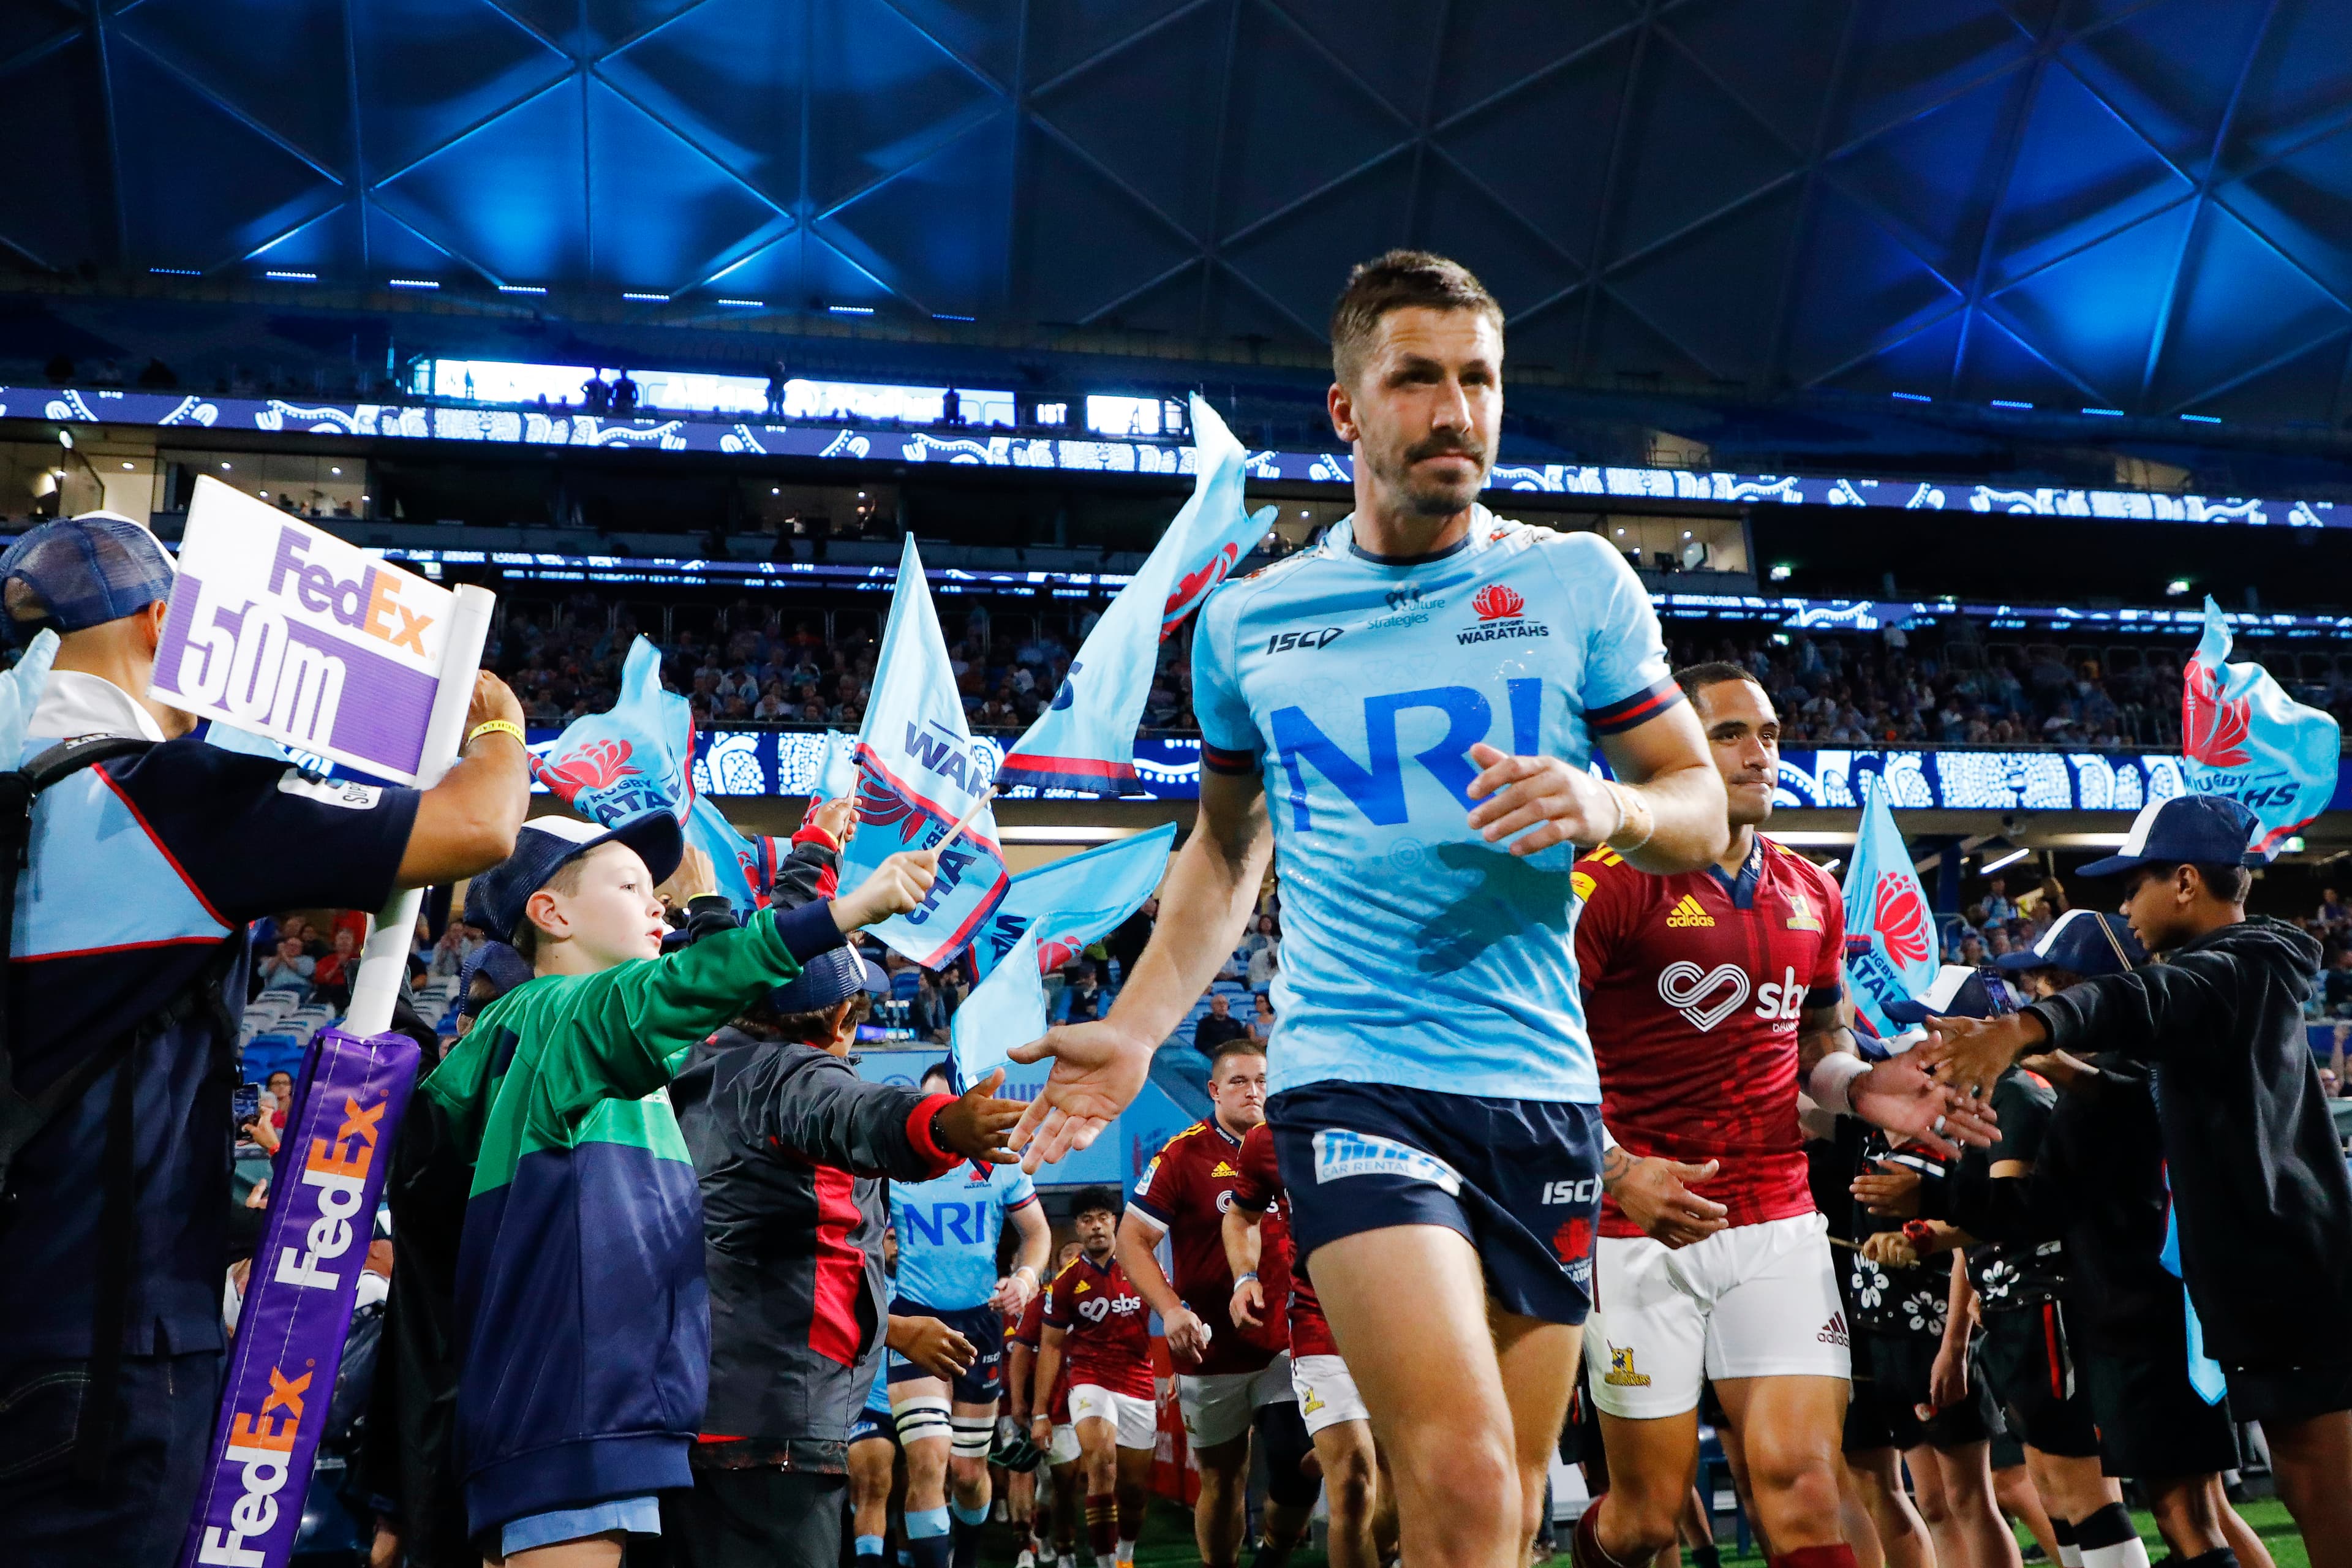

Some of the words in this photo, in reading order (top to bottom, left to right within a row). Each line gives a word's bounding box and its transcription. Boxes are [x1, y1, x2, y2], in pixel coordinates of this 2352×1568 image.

[268, 525, 435, 657] FedEx
[1457, 625, 1550, 646] WARATAHS
[177, 597, 347, 747] 50m
[1270, 677, 1542, 833] NRI
[1666, 913, 1716, 928] adidas
[1755, 965, 1811, 1020] sb
[274, 1095, 387, 1291] FedEx
[1322, 1164, 1348, 1179] CAR
[1354, 1161, 1414, 1174] RENTAL
[903, 1200, 987, 1246] NRI
[1110, 1292, 1141, 1313] sbs
[198, 1365, 314, 1568] FedEx
